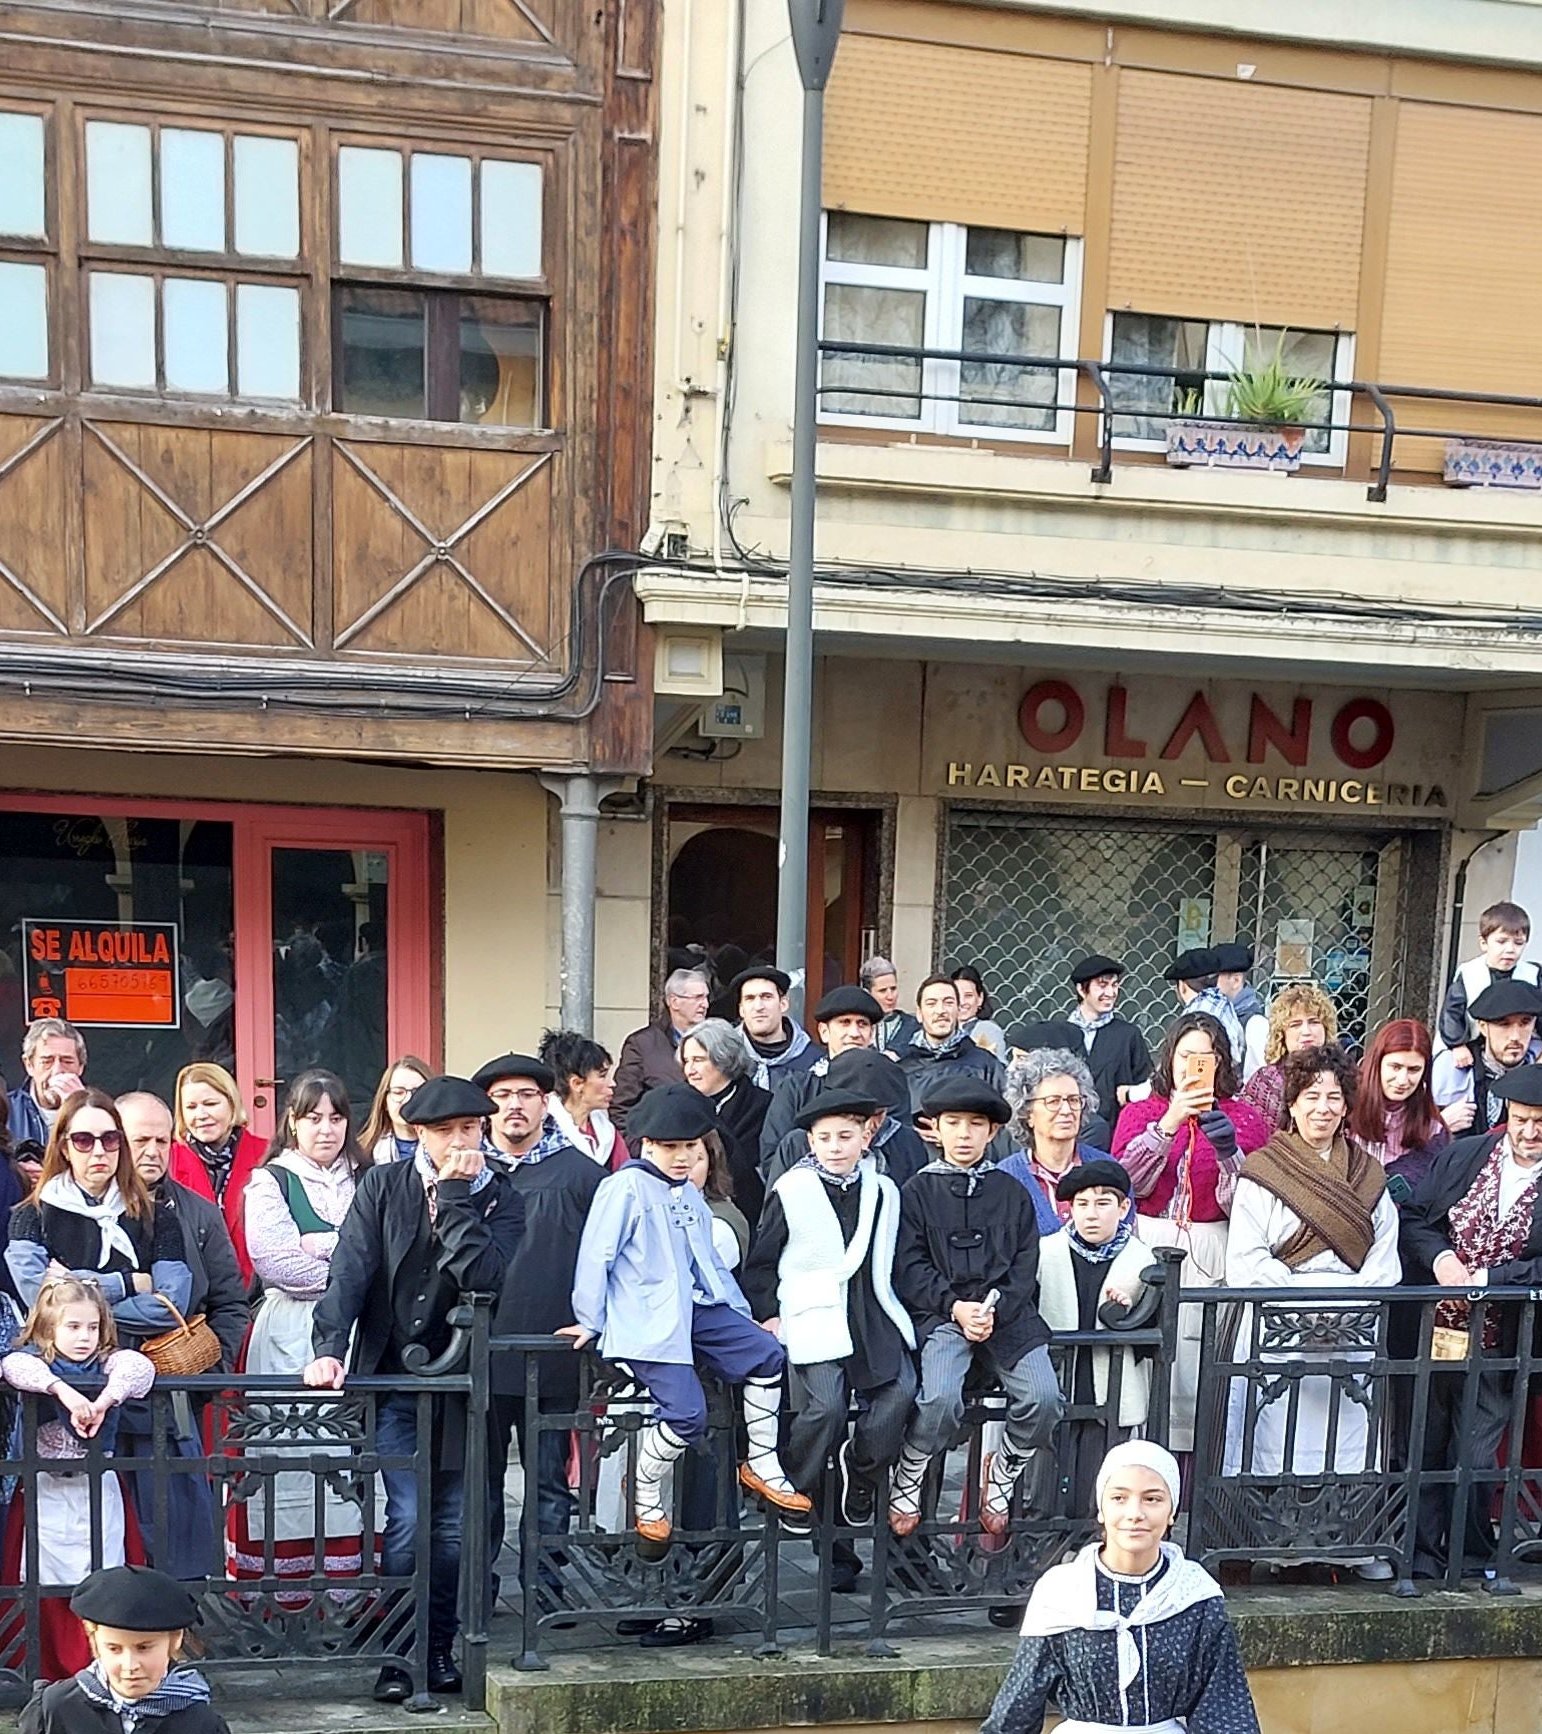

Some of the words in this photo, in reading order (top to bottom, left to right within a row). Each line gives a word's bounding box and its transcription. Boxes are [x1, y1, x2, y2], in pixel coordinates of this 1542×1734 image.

[1017, 678, 1395, 770] OLANO
[947, 762, 1165, 795] HARATEGIA
[1225, 775, 1448, 808] CARNICERIA
[31, 929, 61, 961] SE
[68, 930, 170, 964] ALQUILA
